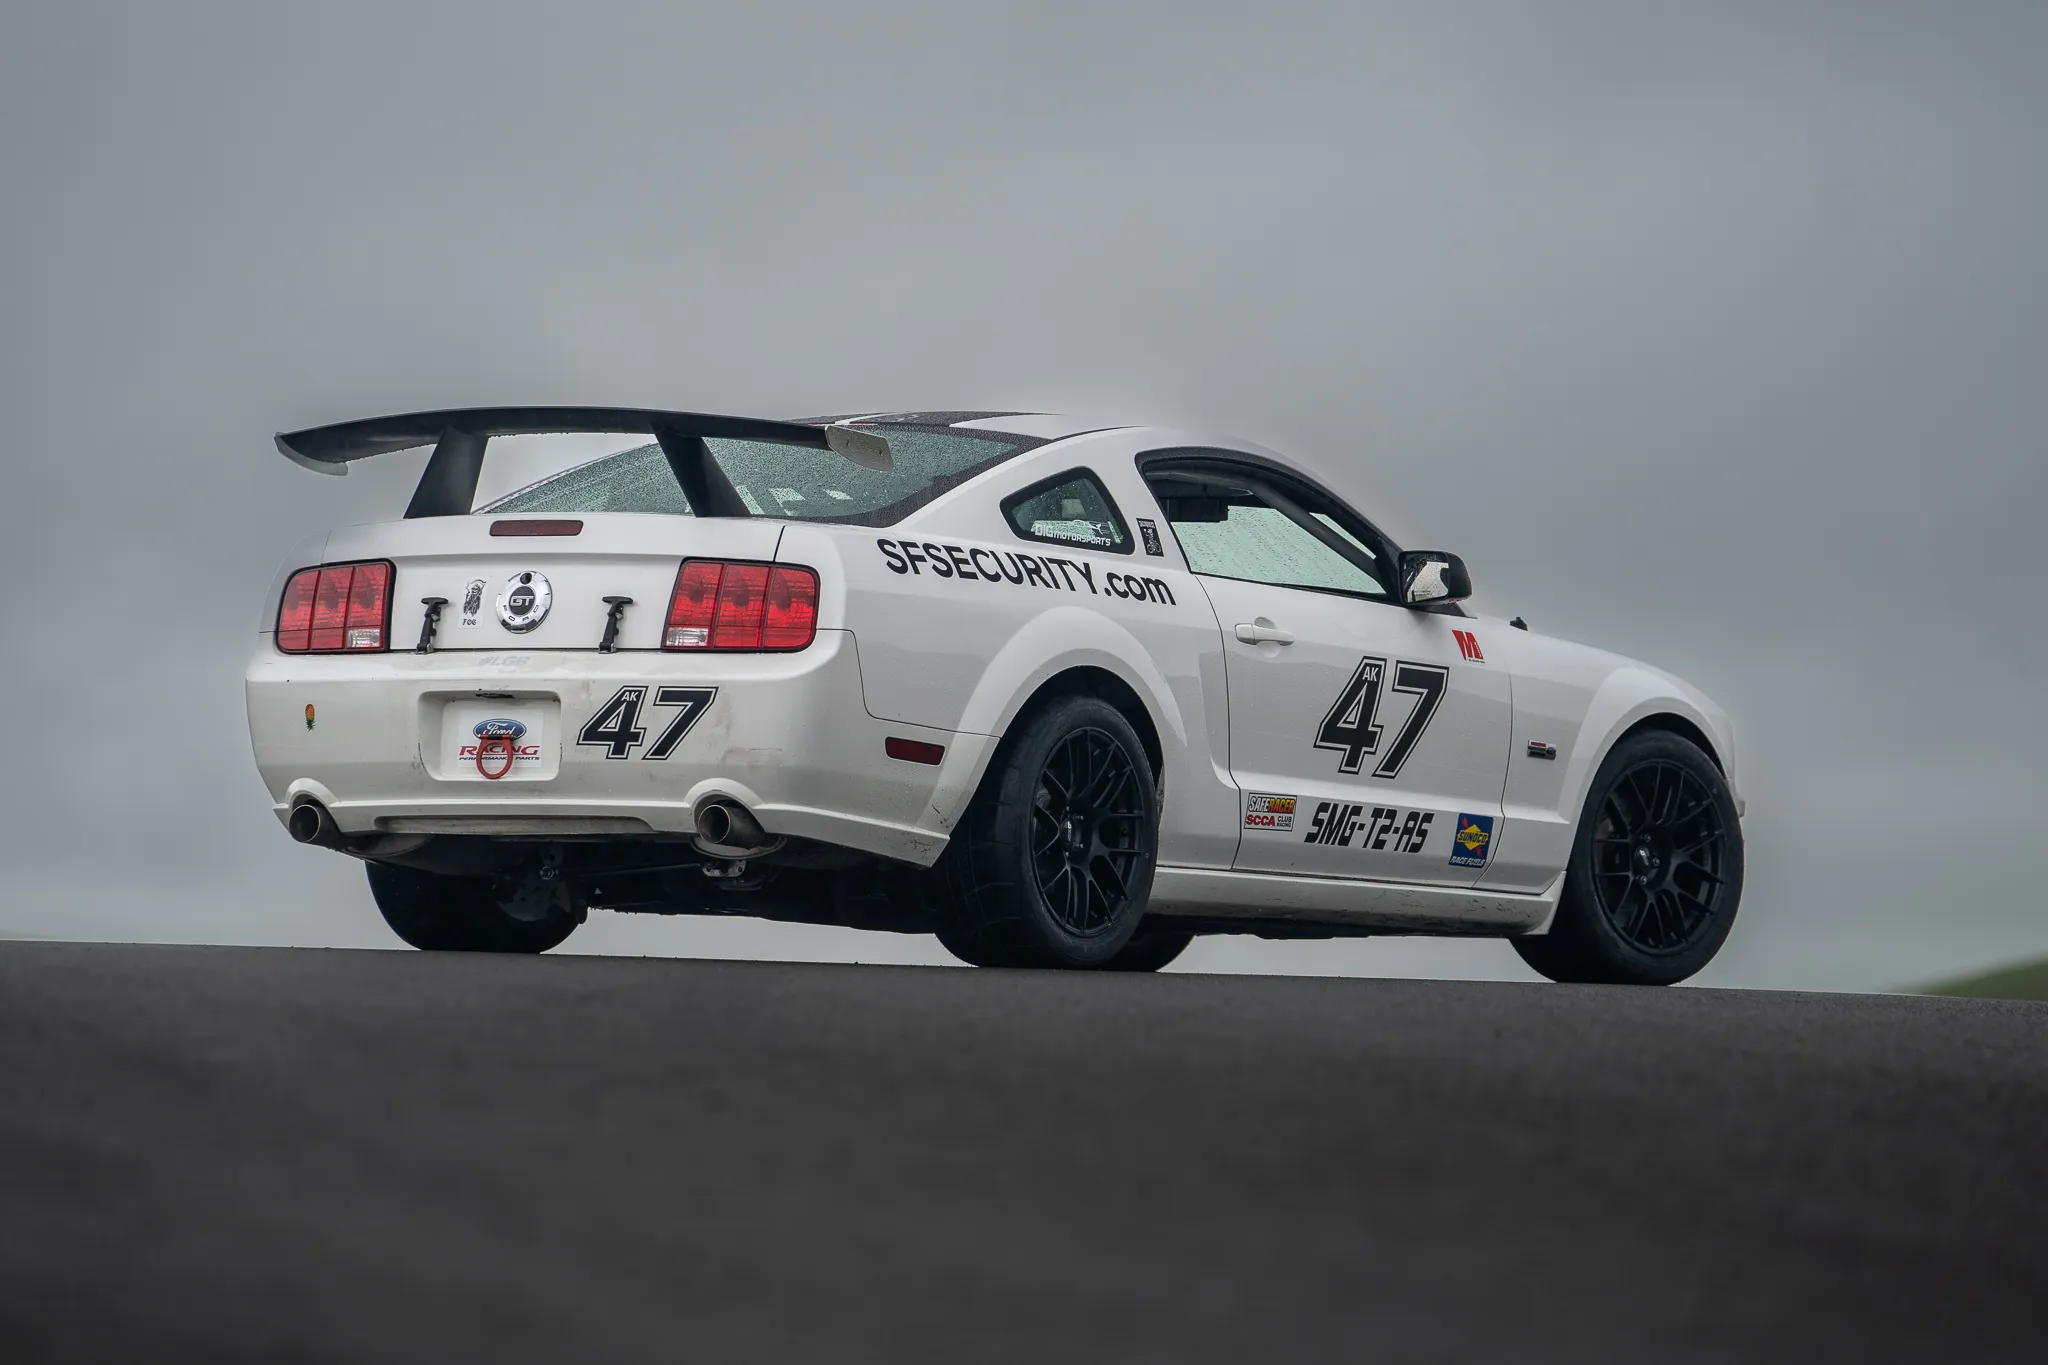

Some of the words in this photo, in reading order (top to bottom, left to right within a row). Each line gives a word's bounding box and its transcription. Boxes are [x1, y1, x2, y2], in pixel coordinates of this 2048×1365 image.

[876, 538, 1177, 606] SFSECURITY.com
[510, 595, 535, 607] GT
[1362, 666, 1379, 682] AK
[620, 691, 639, 702] AK
[576, 685, 719, 761] 47
[1313, 655, 1450, 780] 47
[482, 722, 516, 736] Ford
[1246, 814, 1276, 827] SCCA
[1277, 815, 1293, 823] CLUB
[1304, 801, 1435, 854] SMG-T2-AS
[1458, 831, 1488, 844] SUNOCO
[1450, 855, 1468, 865] RACE
[1466, 857, 1486, 866] FUELS
